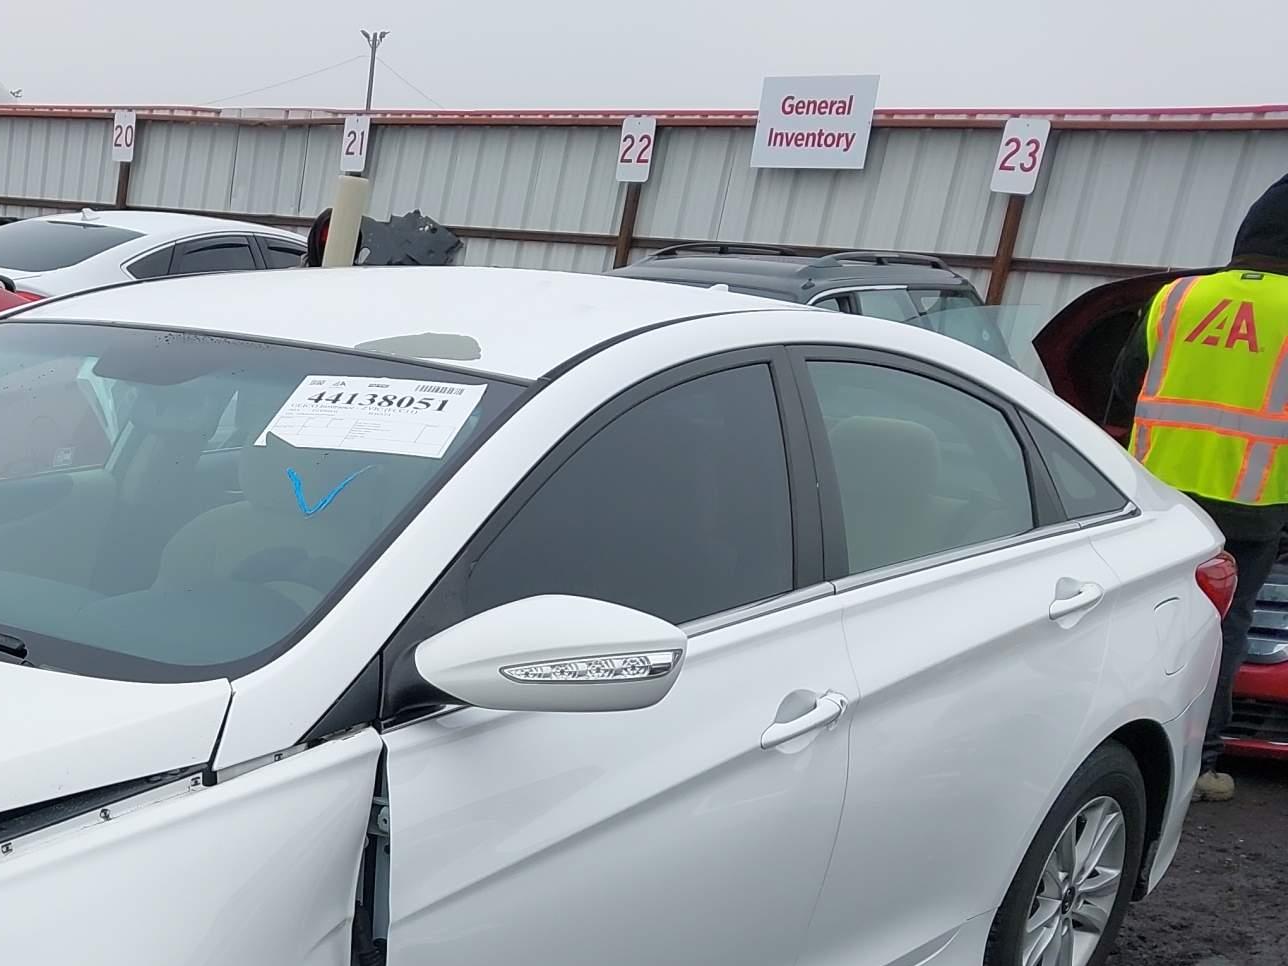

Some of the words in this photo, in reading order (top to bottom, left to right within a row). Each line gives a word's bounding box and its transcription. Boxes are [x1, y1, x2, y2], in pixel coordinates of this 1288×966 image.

[781, 95, 854, 116] General
[114, 125, 134, 147] 20
[345, 130, 365, 156] 21
[767, 127, 856, 152] Inventory
[620, 134, 651, 164] 22
[999, 137, 1041, 173] 23
[307, 391, 449, 412] 44138051
